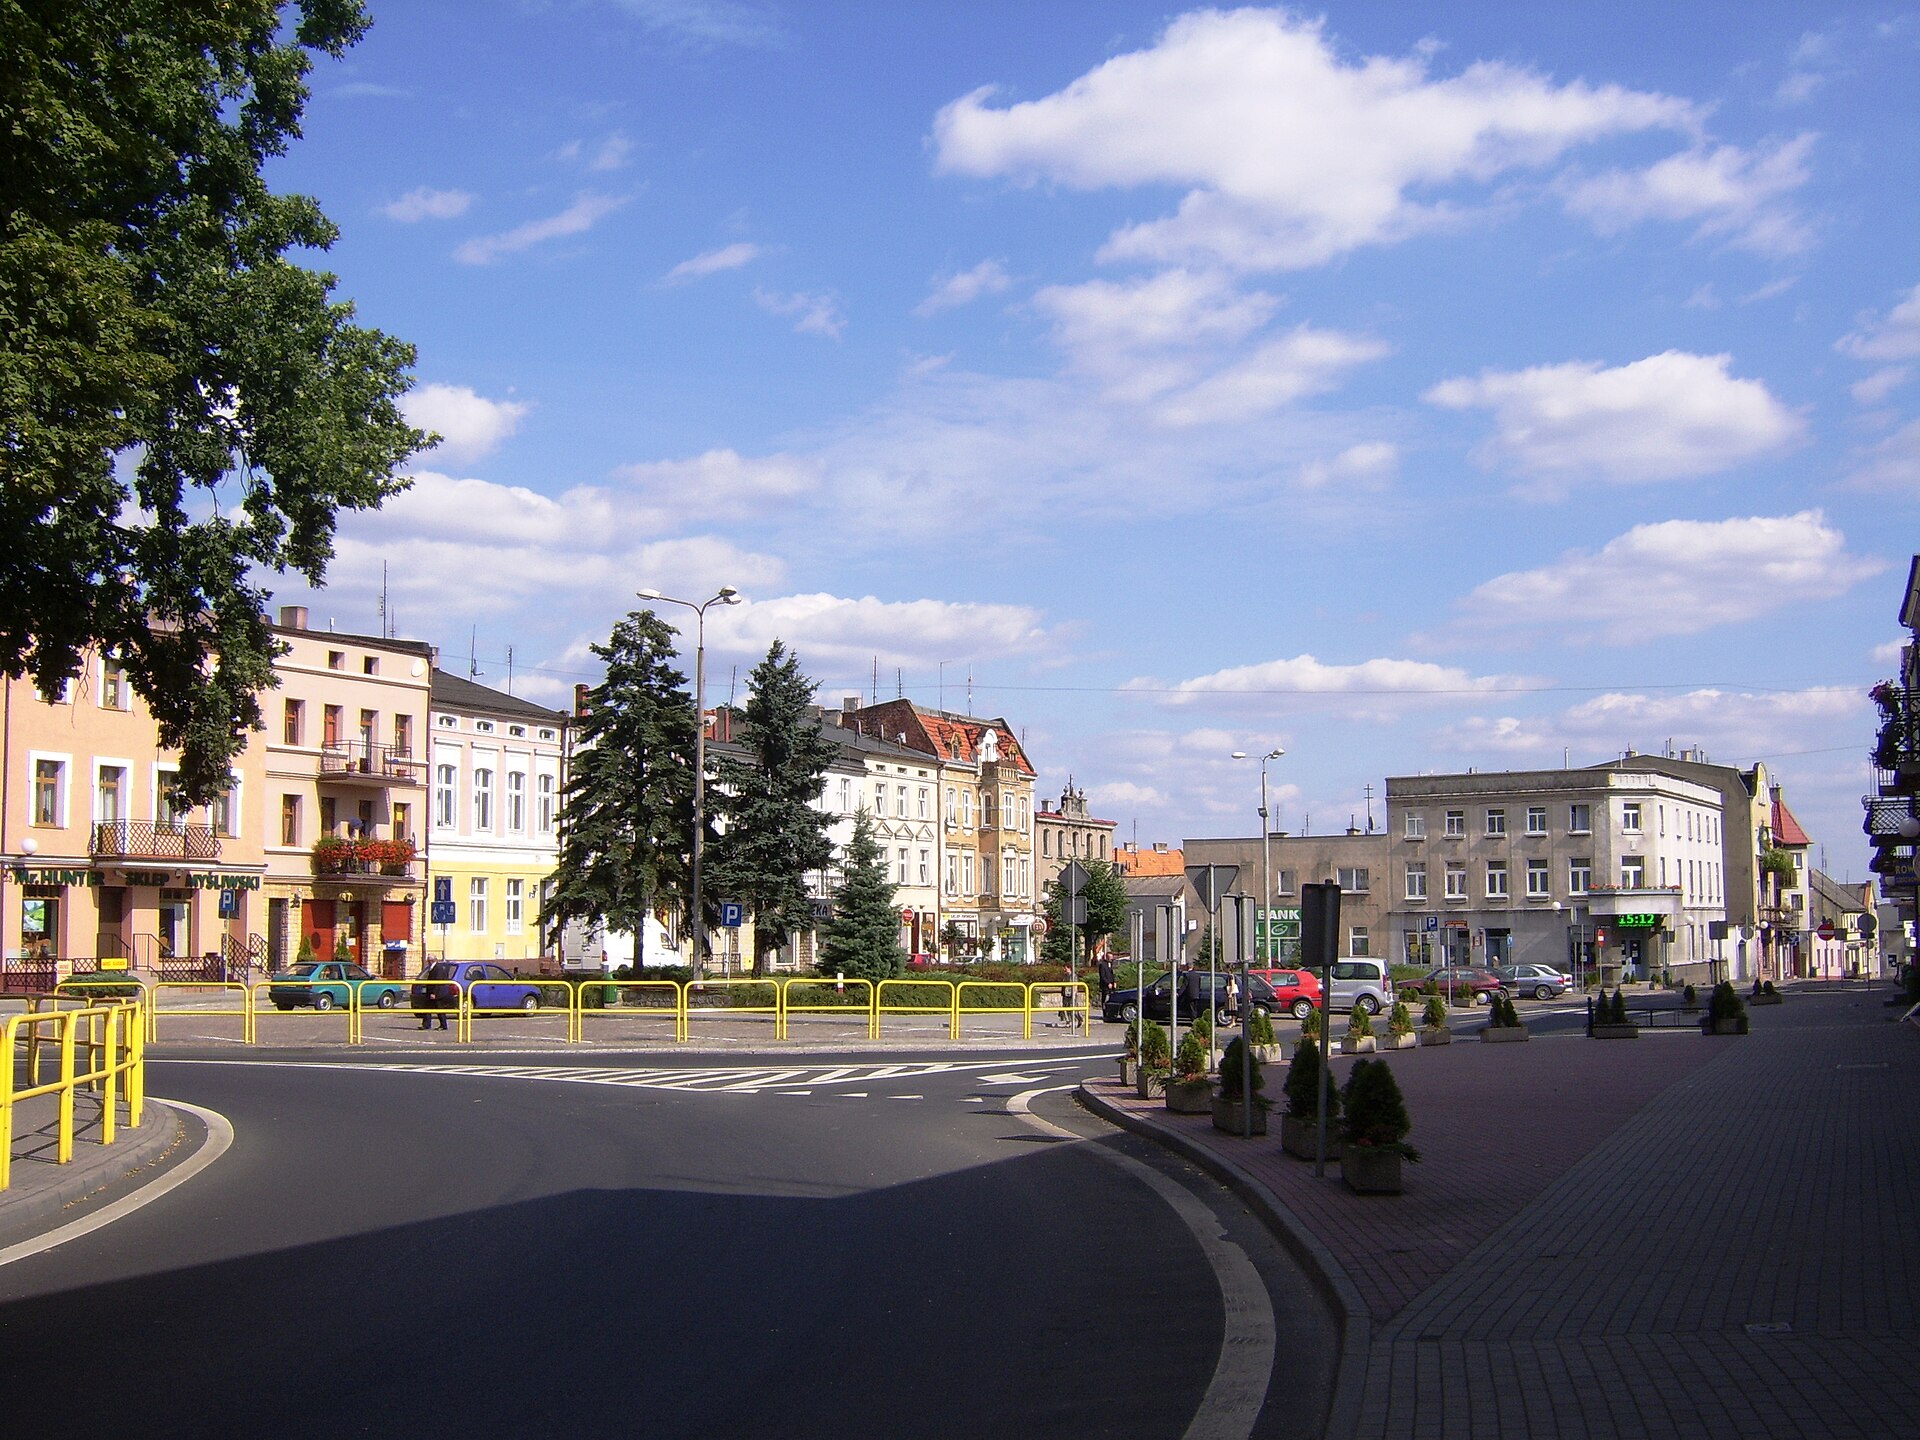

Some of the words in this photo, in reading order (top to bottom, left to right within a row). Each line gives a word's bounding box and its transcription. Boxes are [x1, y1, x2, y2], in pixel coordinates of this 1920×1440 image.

[41, 869, 104, 887] HUNTER
[125, 872, 169, 886] SKLEP
[186, 871, 260, 890] MYŚLIWSKI
[222, 892, 232, 909] P
[726, 905, 738, 924] P
[1257, 909, 1300, 920] BANK
[1618, 914, 1655, 924] 15:12
[1428, 917, 1436, 928] P
